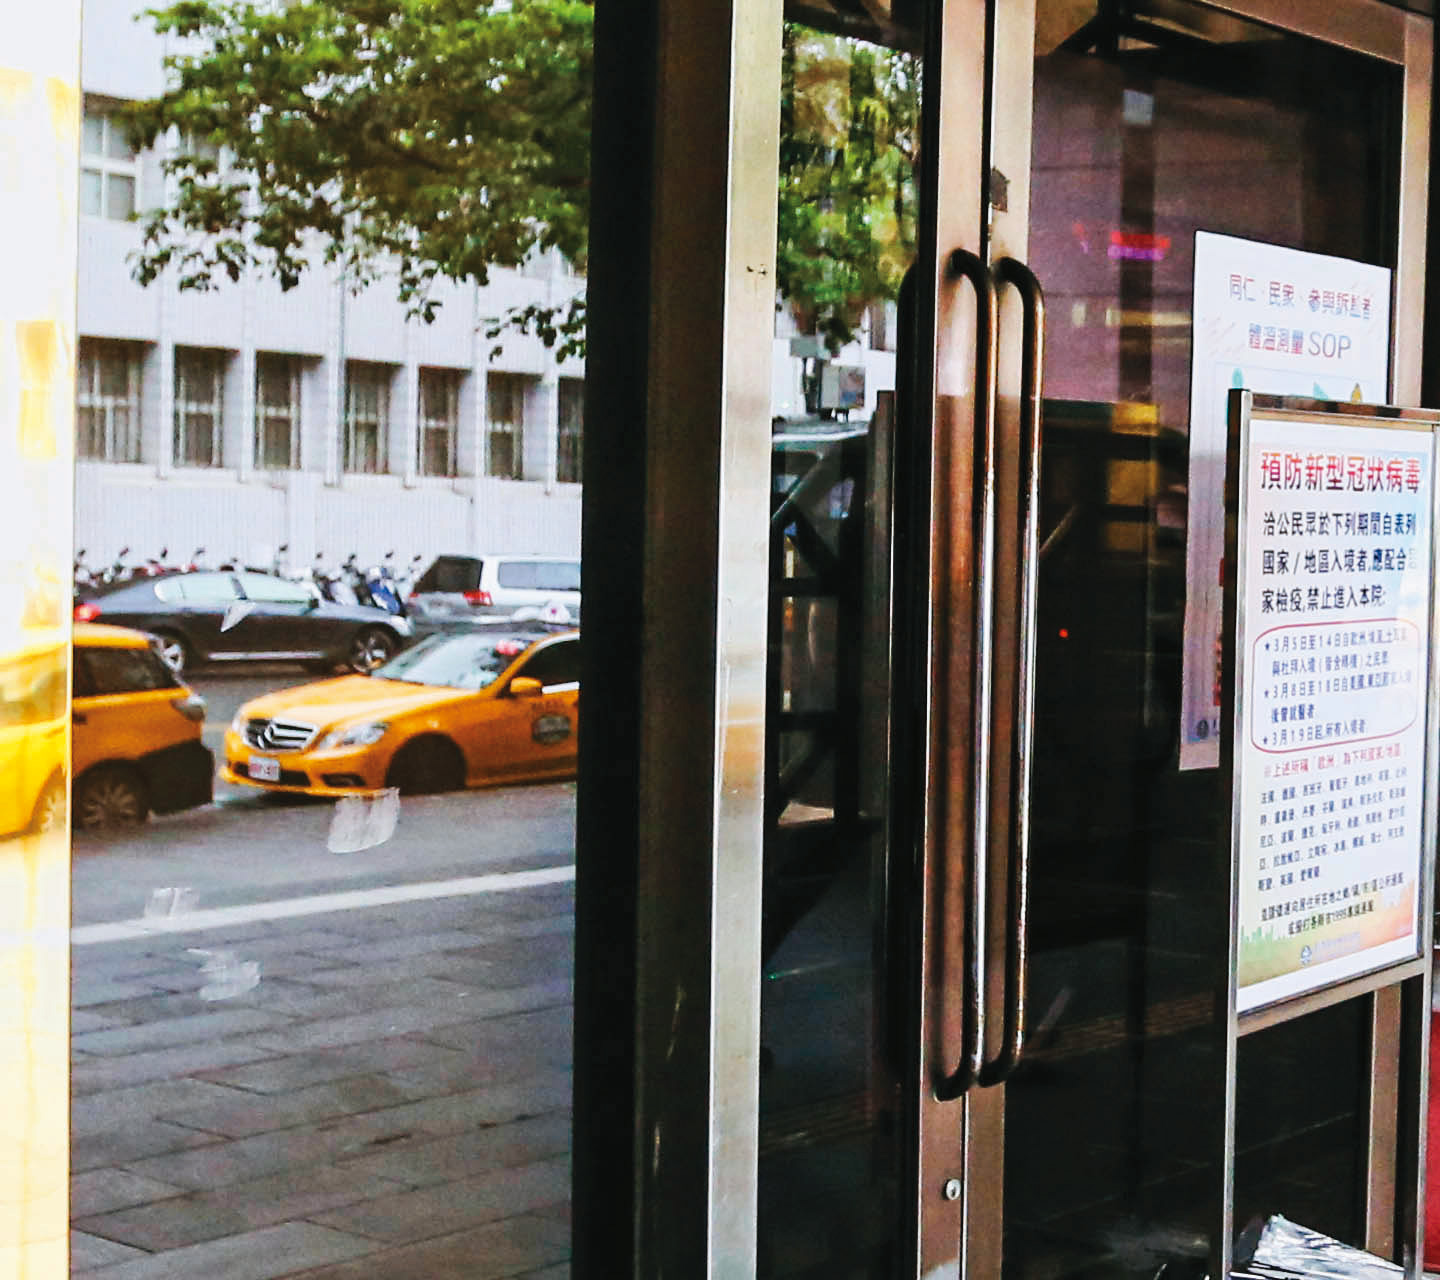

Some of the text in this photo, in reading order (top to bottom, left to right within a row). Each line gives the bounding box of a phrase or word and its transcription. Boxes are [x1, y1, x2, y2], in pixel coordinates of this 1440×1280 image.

[1308, 330, 1352, 359] SOP
[1260, 452, 1421, 494] 預防新型冠狀病毒
